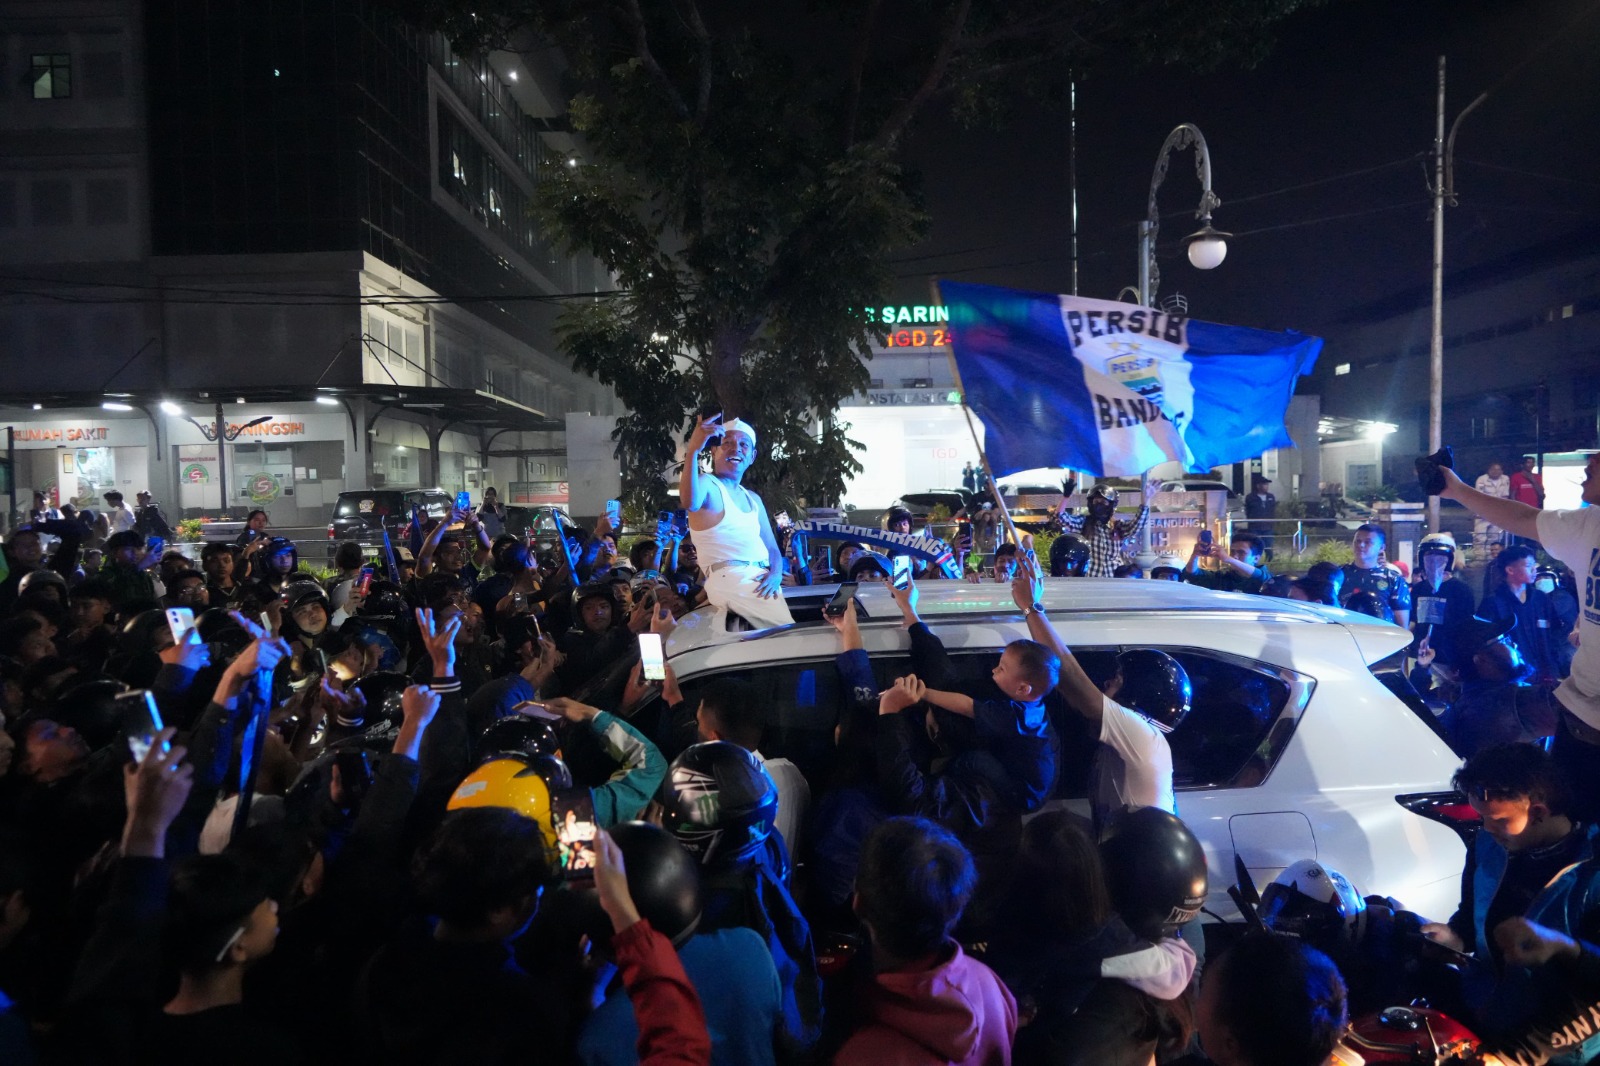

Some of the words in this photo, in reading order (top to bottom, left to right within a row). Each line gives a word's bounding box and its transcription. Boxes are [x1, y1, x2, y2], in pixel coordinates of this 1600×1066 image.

[882, 305, 950, 324] SARIN
[1066, 309, 1185, 348] PERSIB
[888, 329, 927, 347] IGD
[1095, 393, 1185, 431] BAND
[13, 428, 63, 441] RUMAH
[66, 427, 110, 441] SAKIT
[932, 448, 957, 459] IGD
[1149, 517, 1201, 528] BANDUNG
